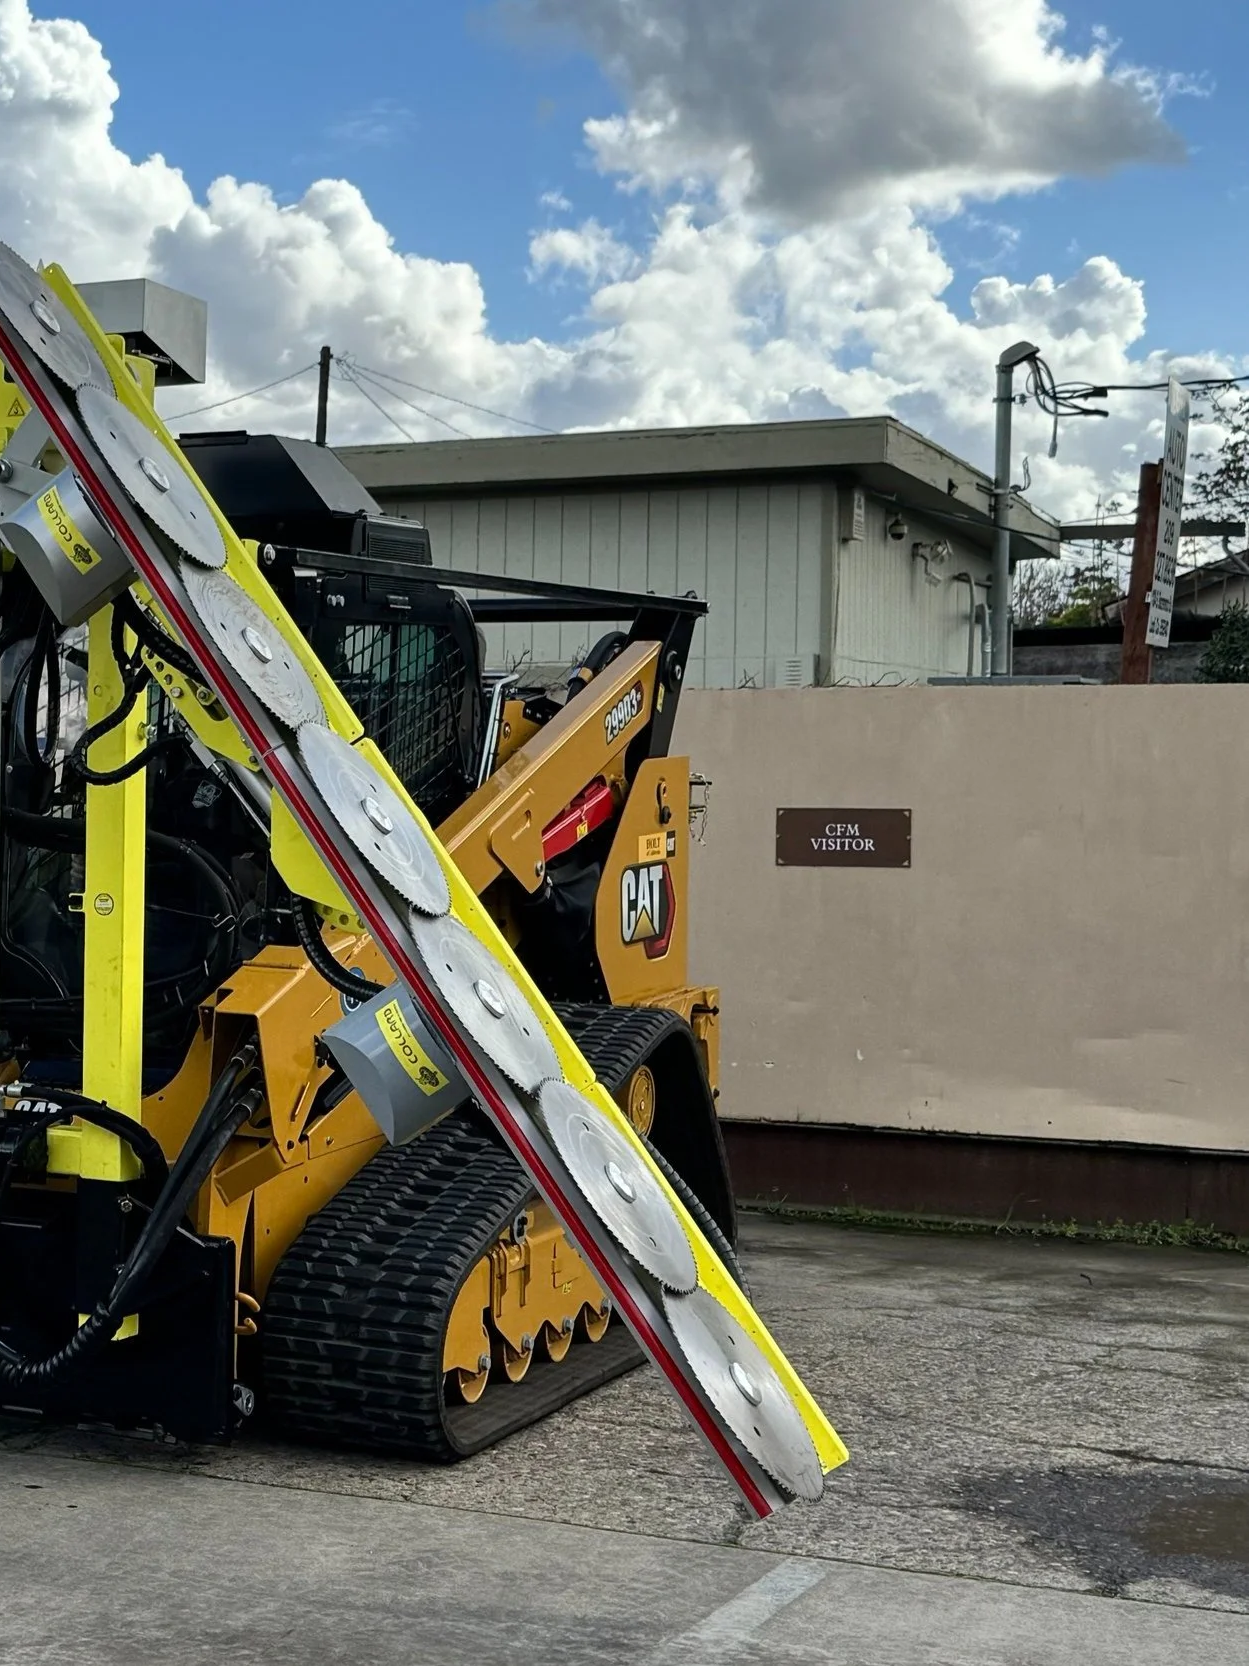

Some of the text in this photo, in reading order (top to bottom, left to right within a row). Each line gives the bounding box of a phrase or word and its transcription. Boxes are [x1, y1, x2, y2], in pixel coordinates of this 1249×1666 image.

[1167, 428, 1186, 470] AUTO
[43, 493, 73, 542] COLLARD
[810, 838, 876, 851] VISITOR
[825, 823, 860, 836] CFM
[621, 863, 663, 943] CAT
[383, 1008, 419, 1064] COLLARD
